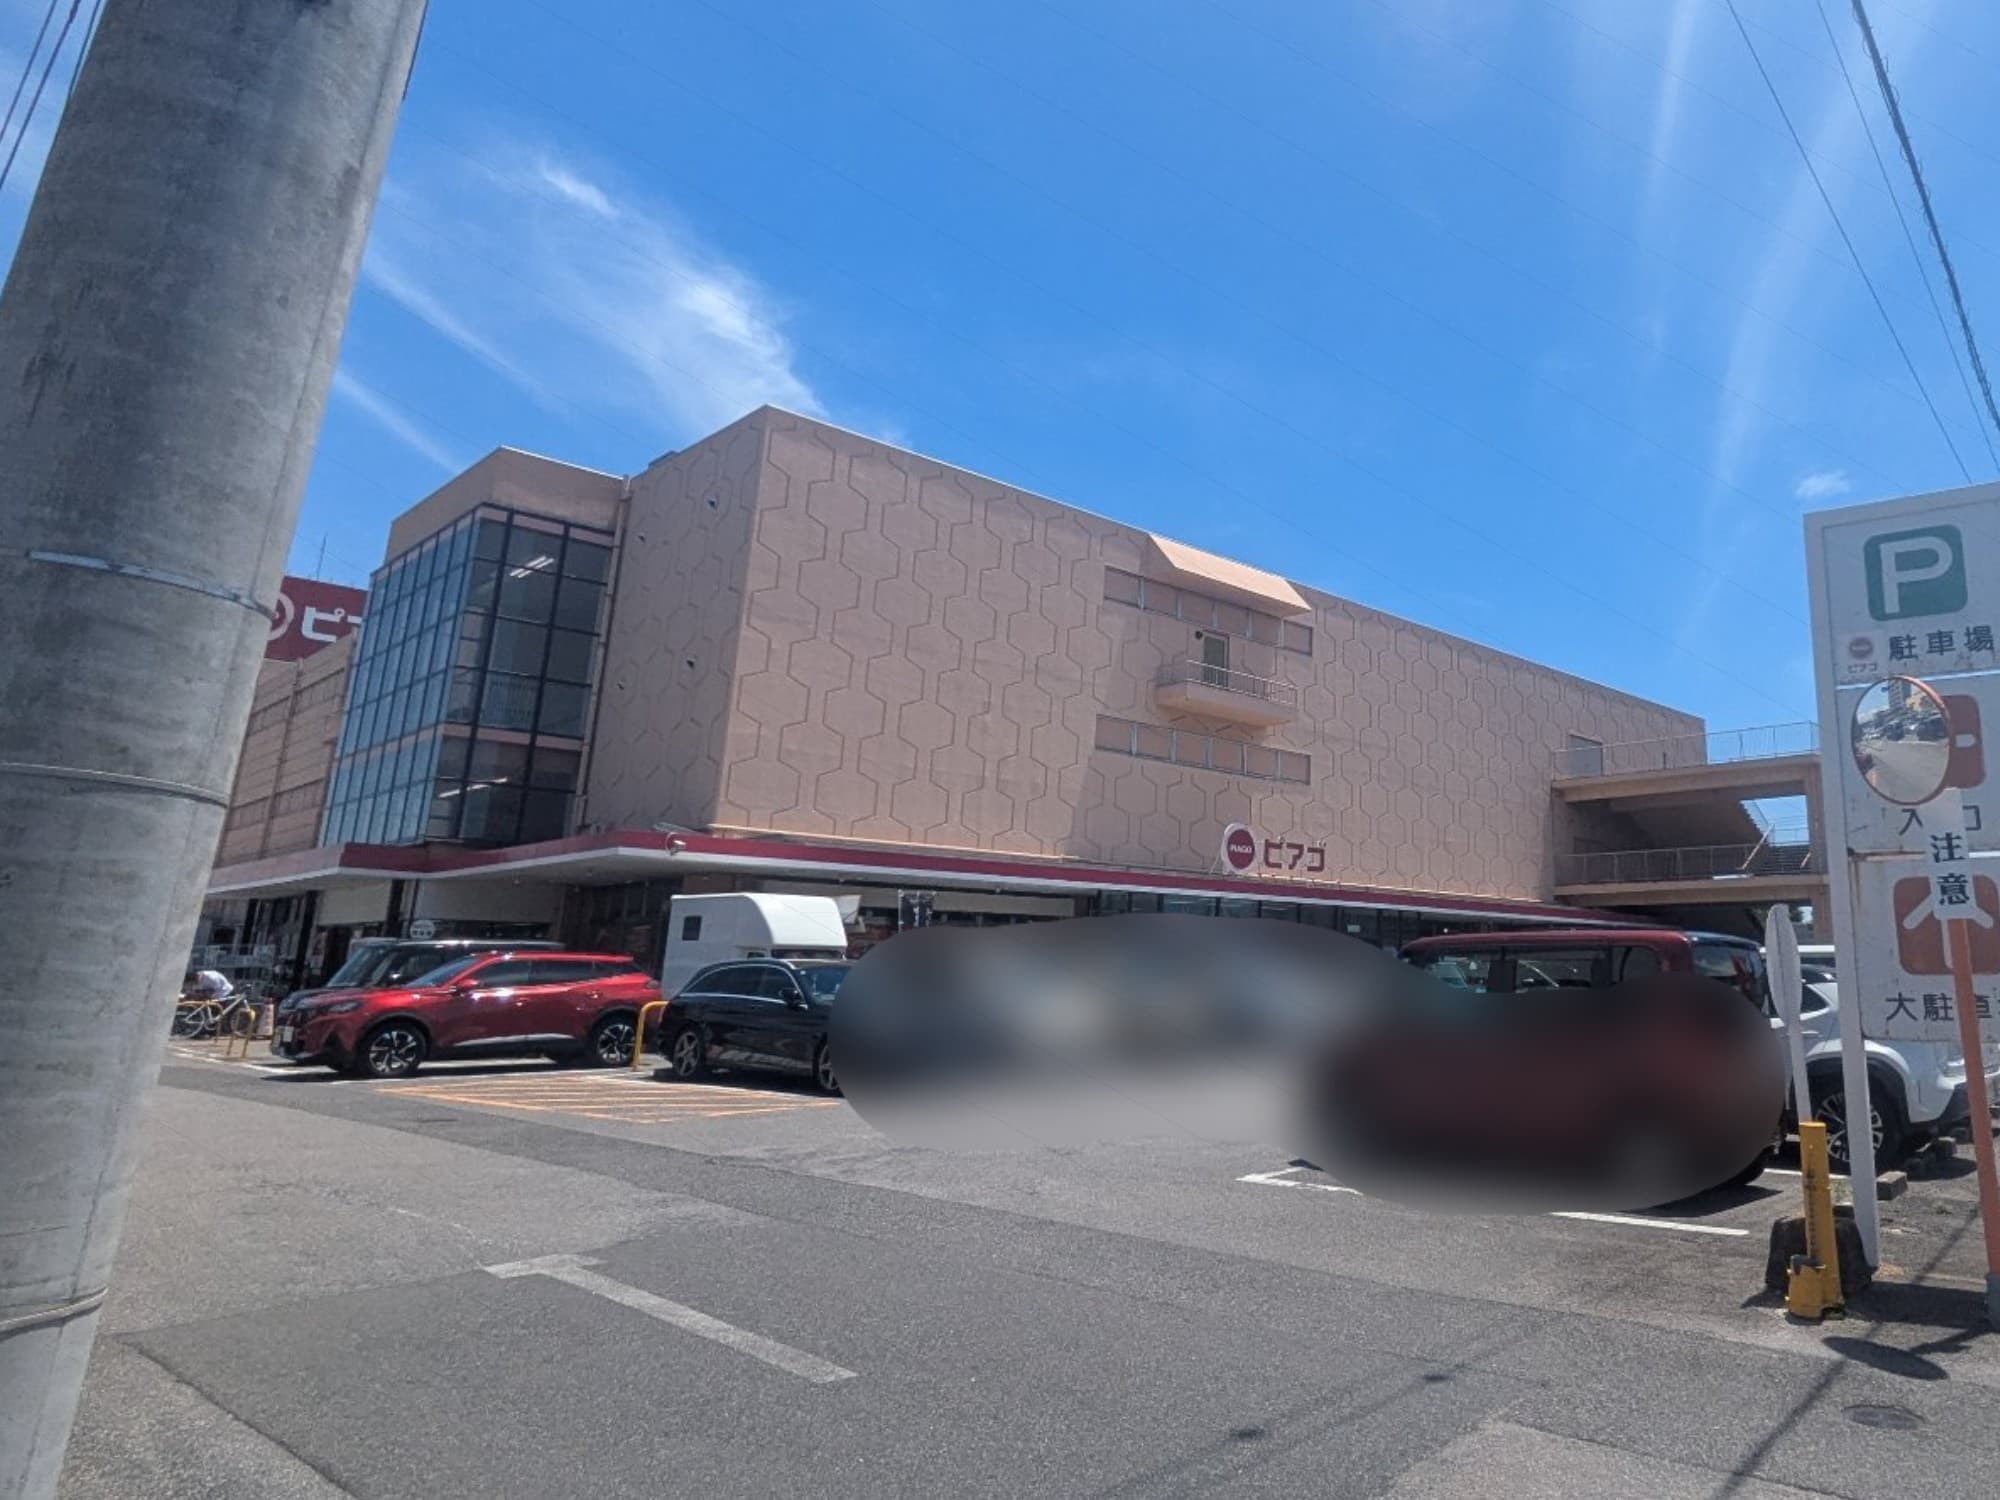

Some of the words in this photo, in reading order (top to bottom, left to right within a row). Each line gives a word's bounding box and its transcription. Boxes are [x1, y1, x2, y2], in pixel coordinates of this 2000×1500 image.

[1879, 536, 1953, 614] P
[302, 606, 363, 643] ピ
[1889, 626, 1994, 661] 駐車場
[1264, 836, 1327, 872] ピアゴ
[1930, 831, 1970, 906] 注意
[1885, 991, 2000, 1022] 大駐車
